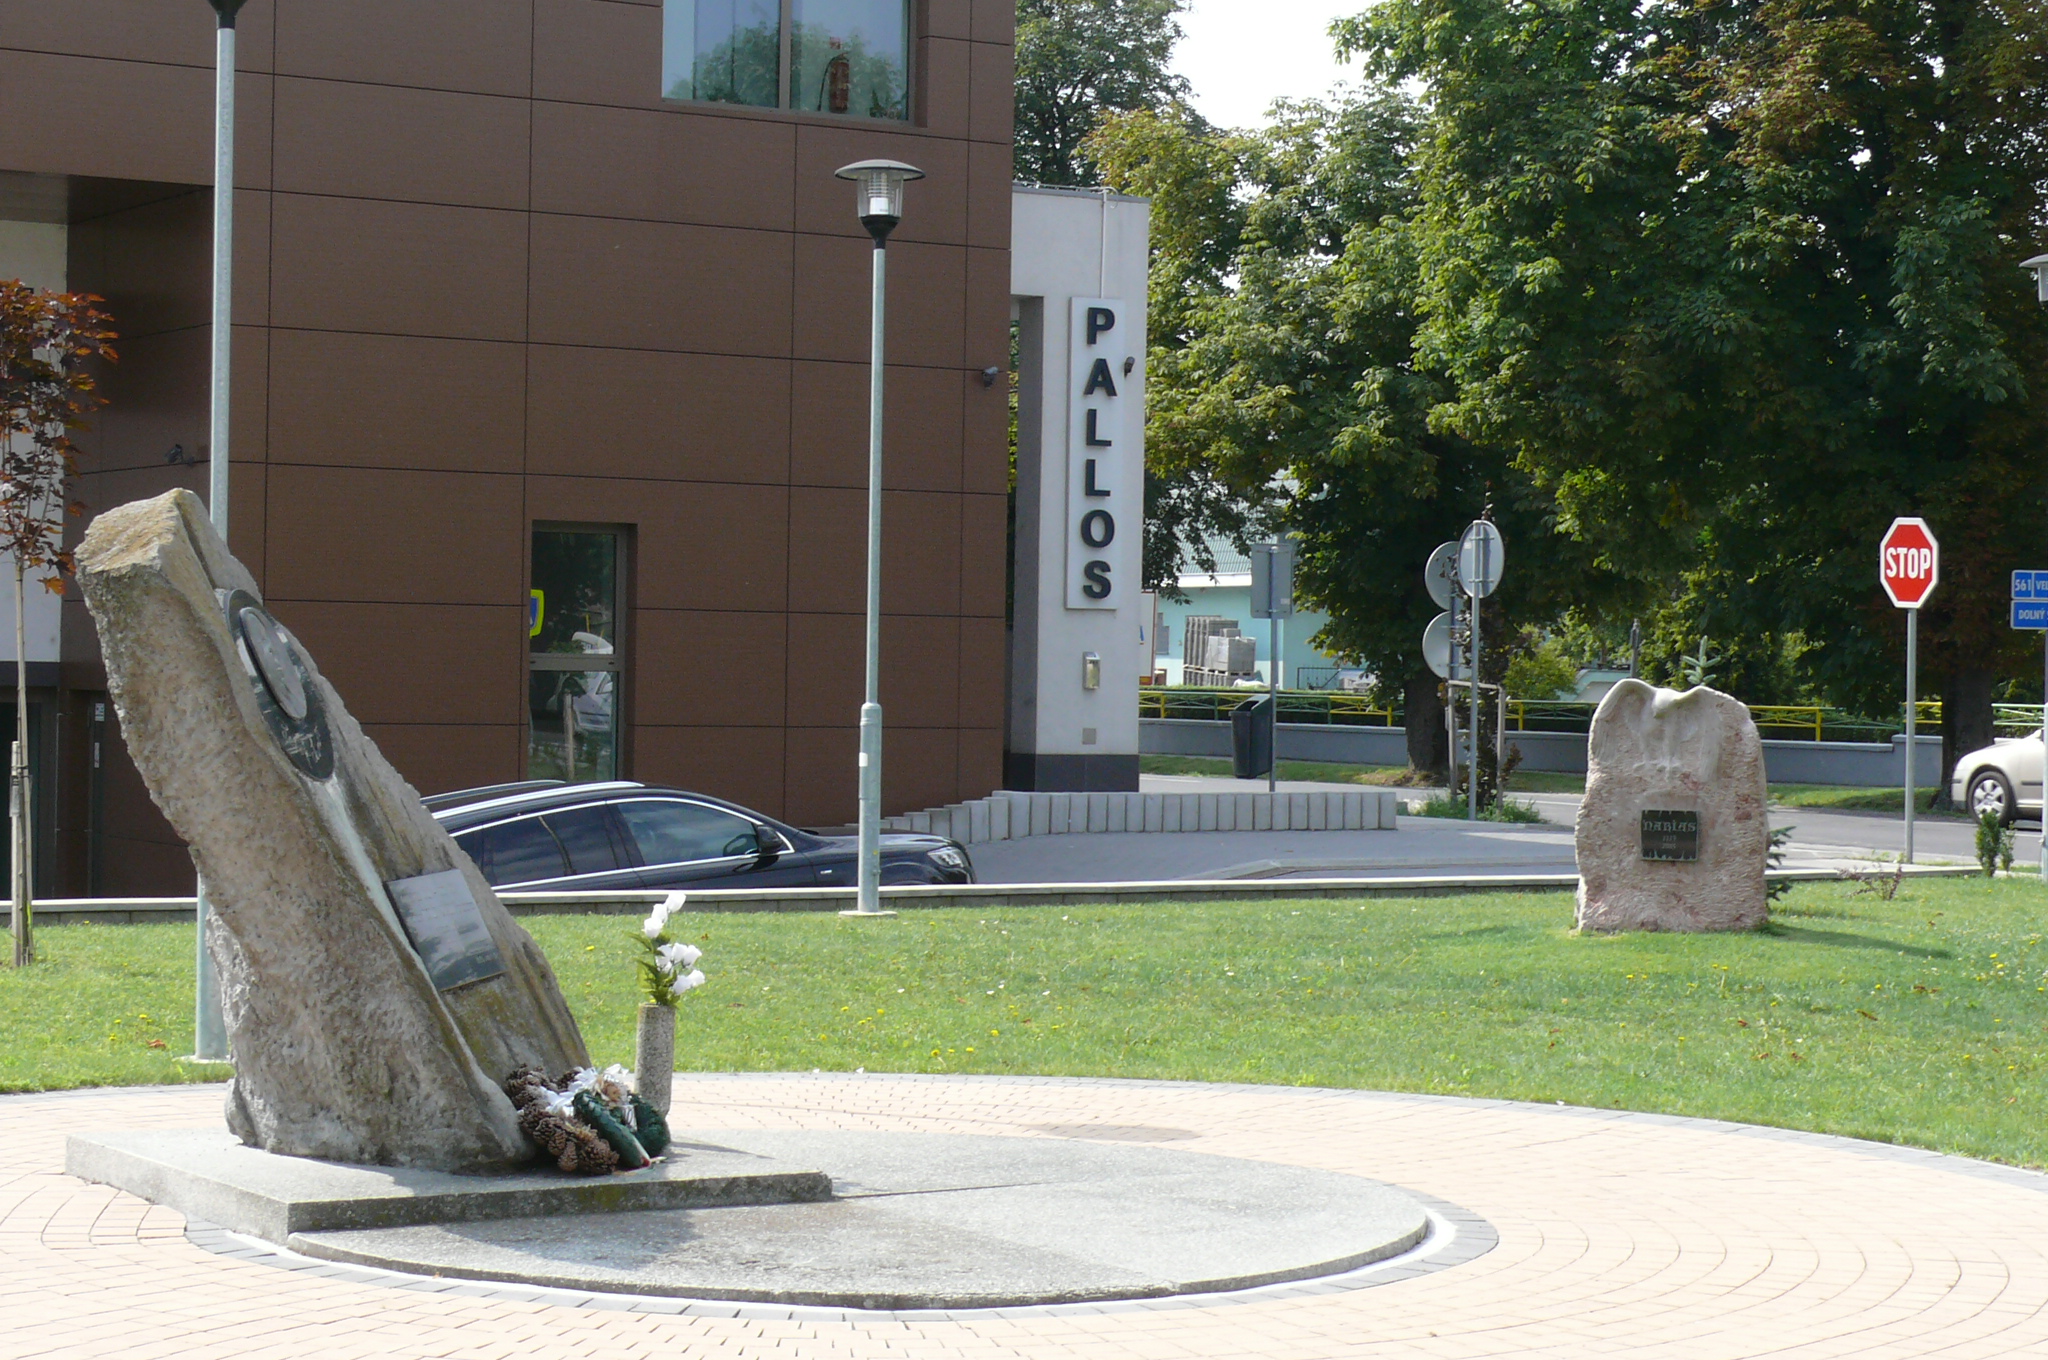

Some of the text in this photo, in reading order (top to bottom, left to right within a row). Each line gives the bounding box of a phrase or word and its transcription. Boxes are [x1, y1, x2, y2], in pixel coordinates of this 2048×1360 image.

[1081, 306, 1117, 599] PALLOS
[1886, 547, 1931, 579] STOP
[2015, 579, 2031, 591] 561
[2018, 608, 2045, 620] DOLNÝ
